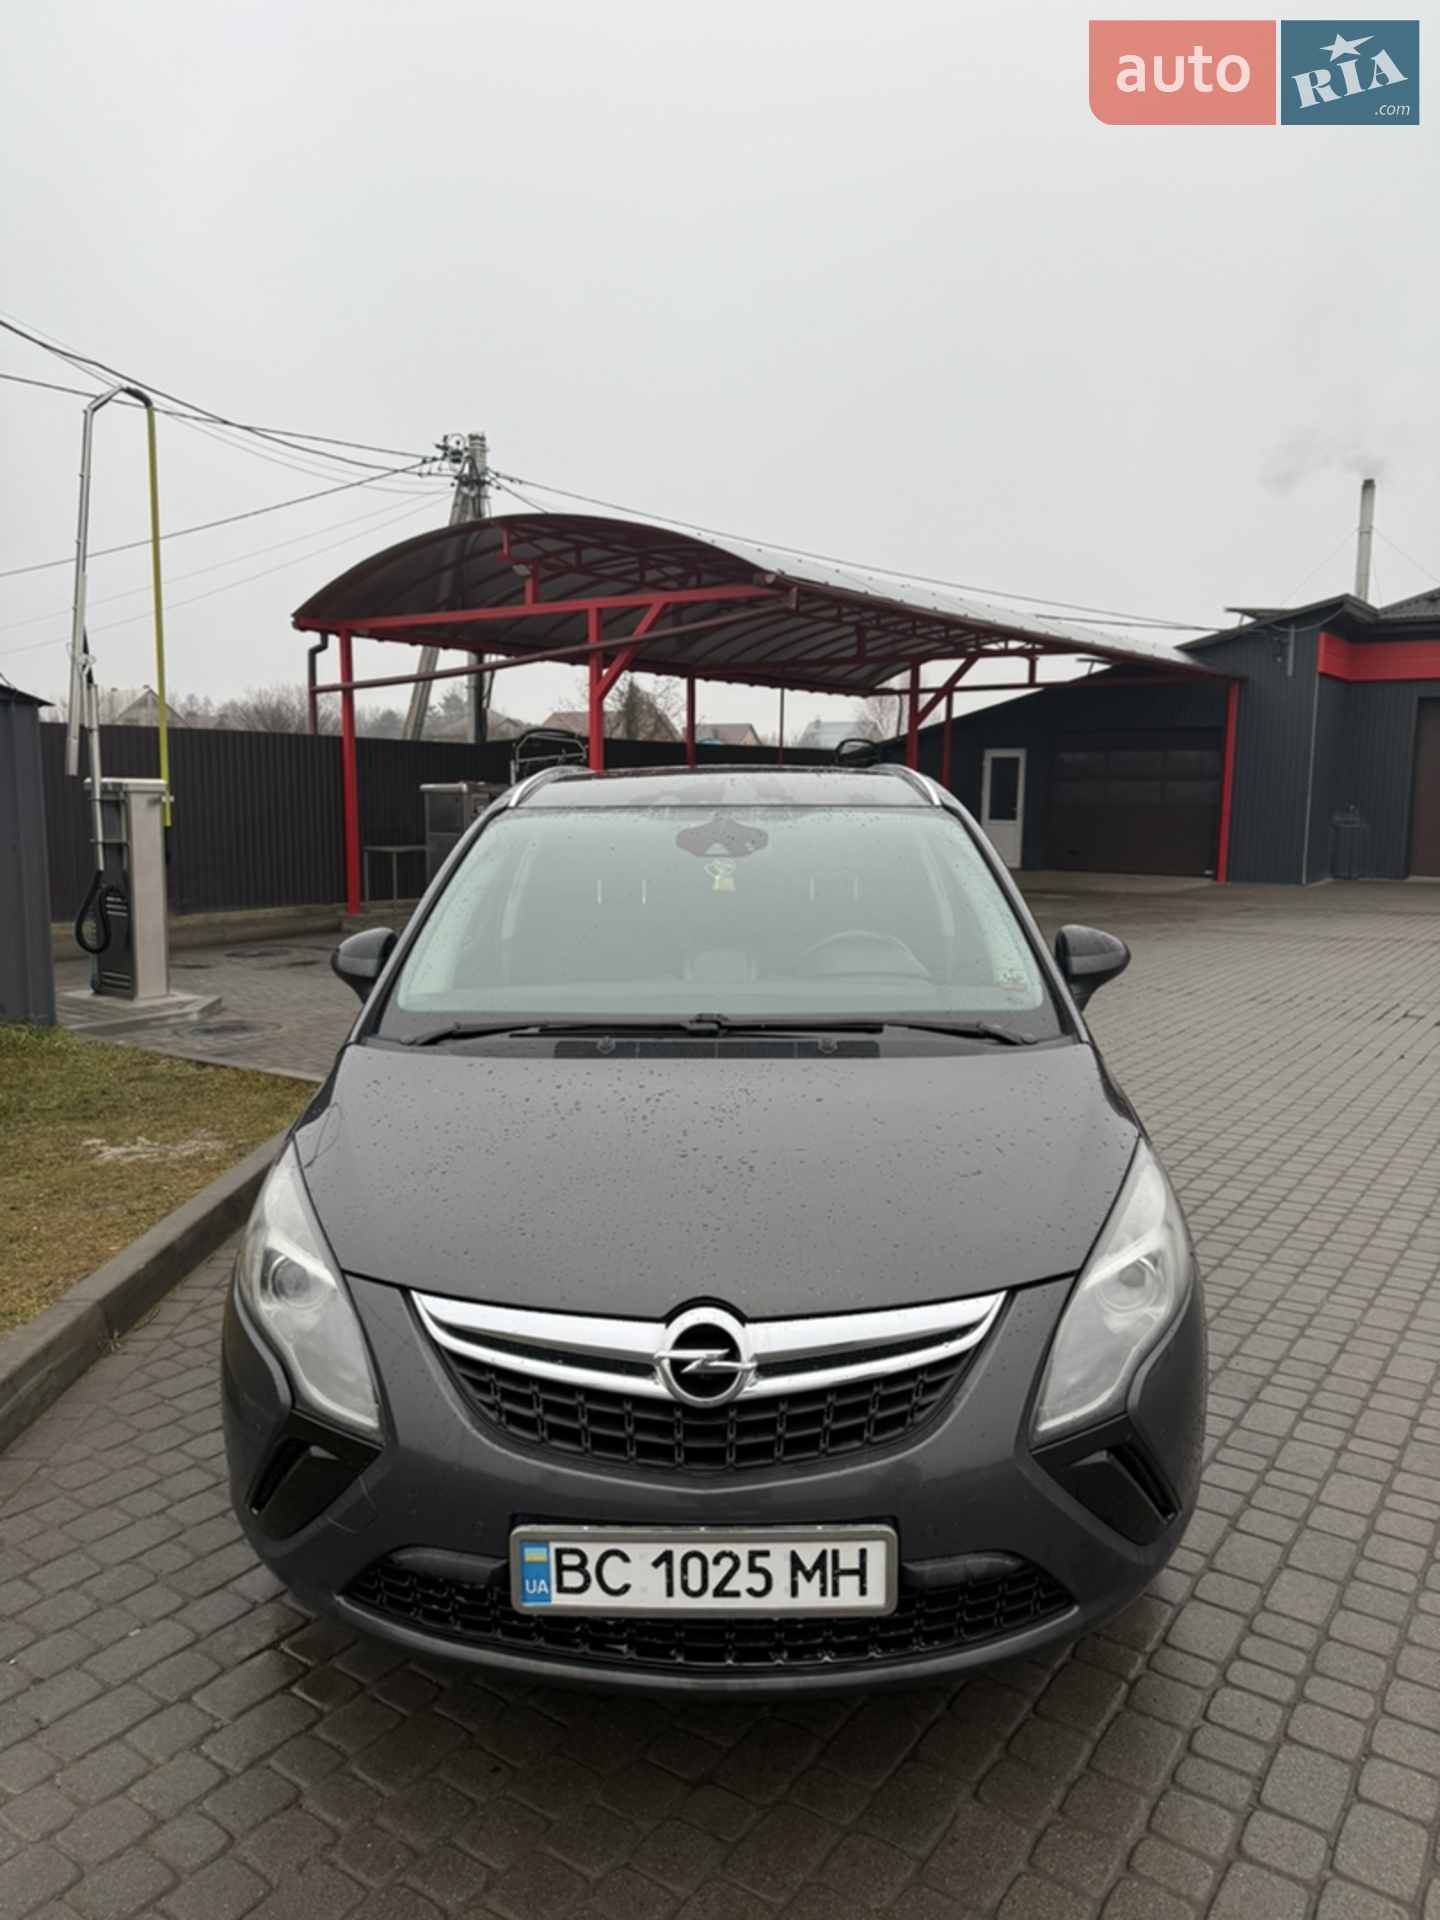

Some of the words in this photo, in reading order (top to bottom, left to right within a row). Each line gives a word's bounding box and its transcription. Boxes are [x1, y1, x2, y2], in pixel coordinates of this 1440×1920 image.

[525, 1580, 549, 1594] UA
[554, 1547, 632, 1596] BC
[651, 1549, 773, 1598] 1025
[790, 1548, 868, 1598] MH
